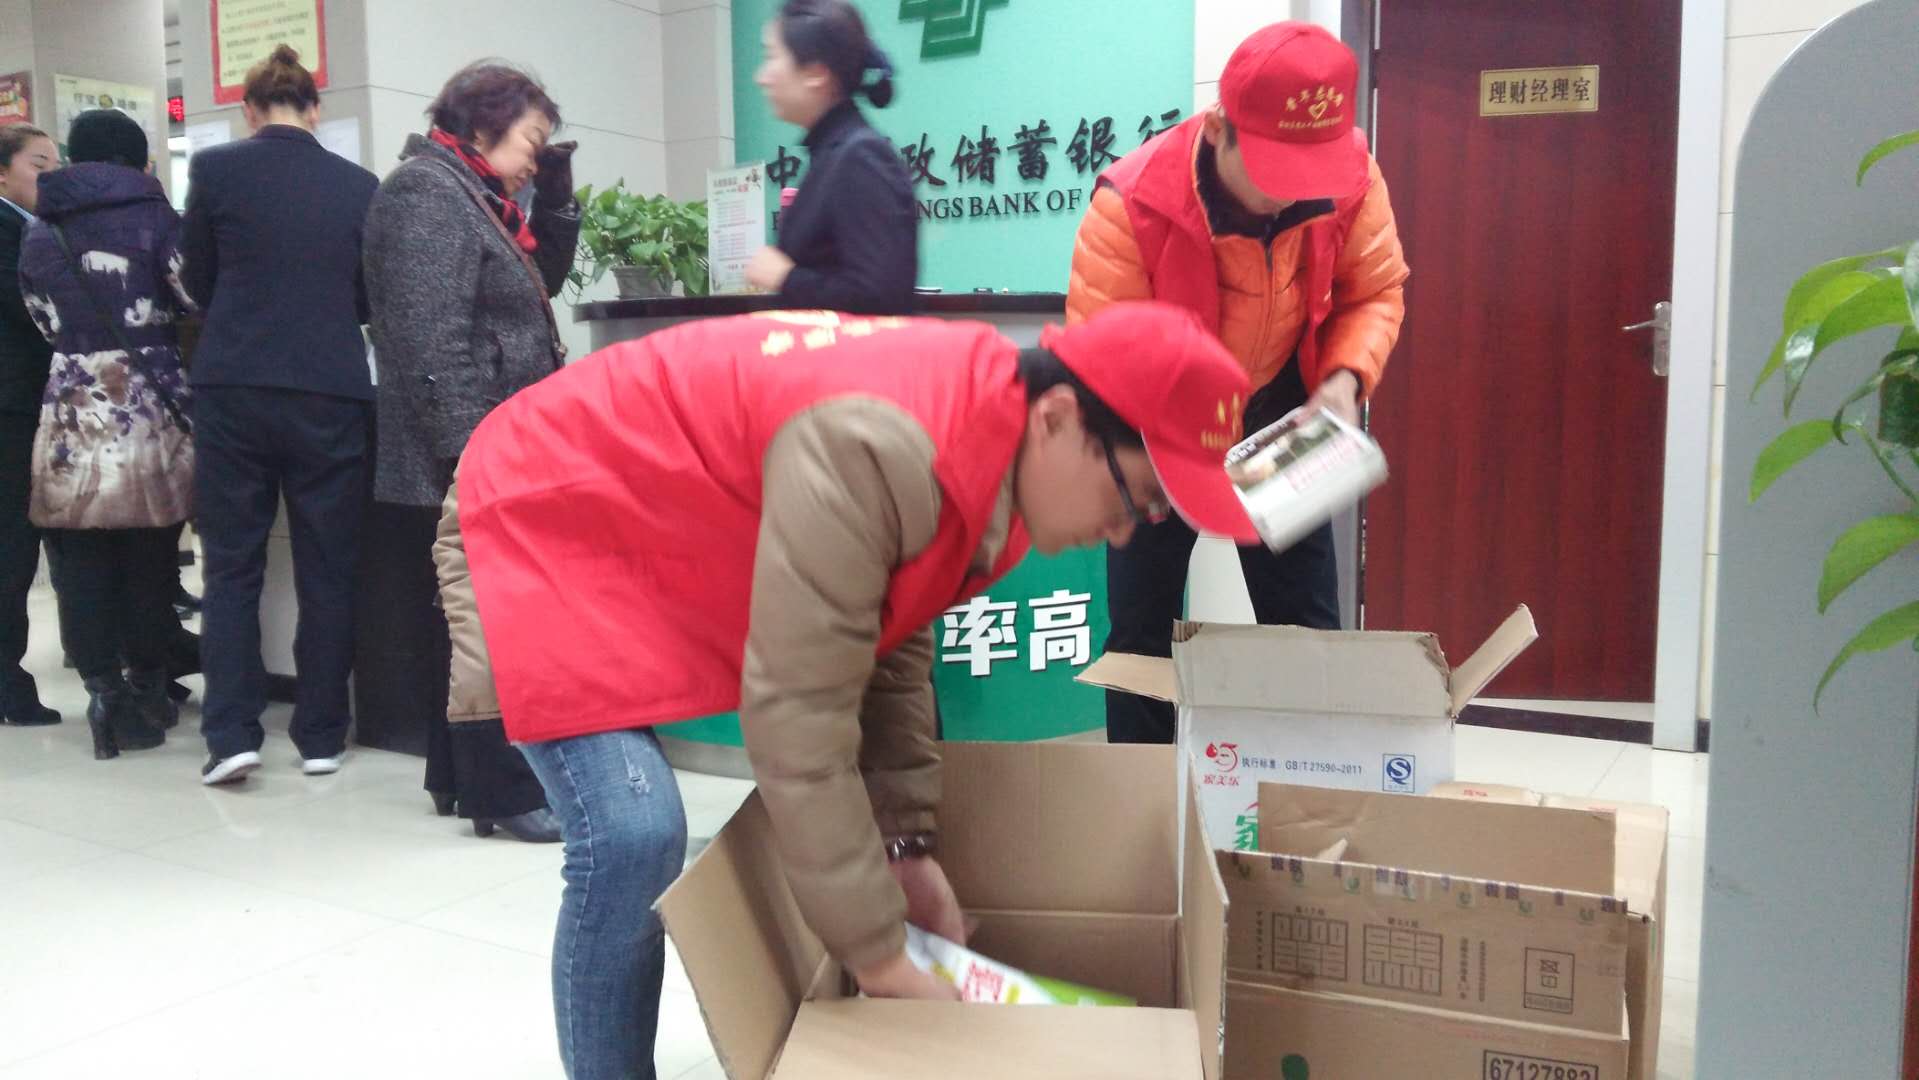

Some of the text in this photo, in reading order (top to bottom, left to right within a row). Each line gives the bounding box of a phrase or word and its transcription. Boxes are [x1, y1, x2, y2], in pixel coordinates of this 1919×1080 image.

[1489, 77, 1591, 104] 理财经理室
[969, 191, 1041, 218] BANK
[1046, 188, 1082, 212] OF
[942, 589, 1092, 677] 率高
